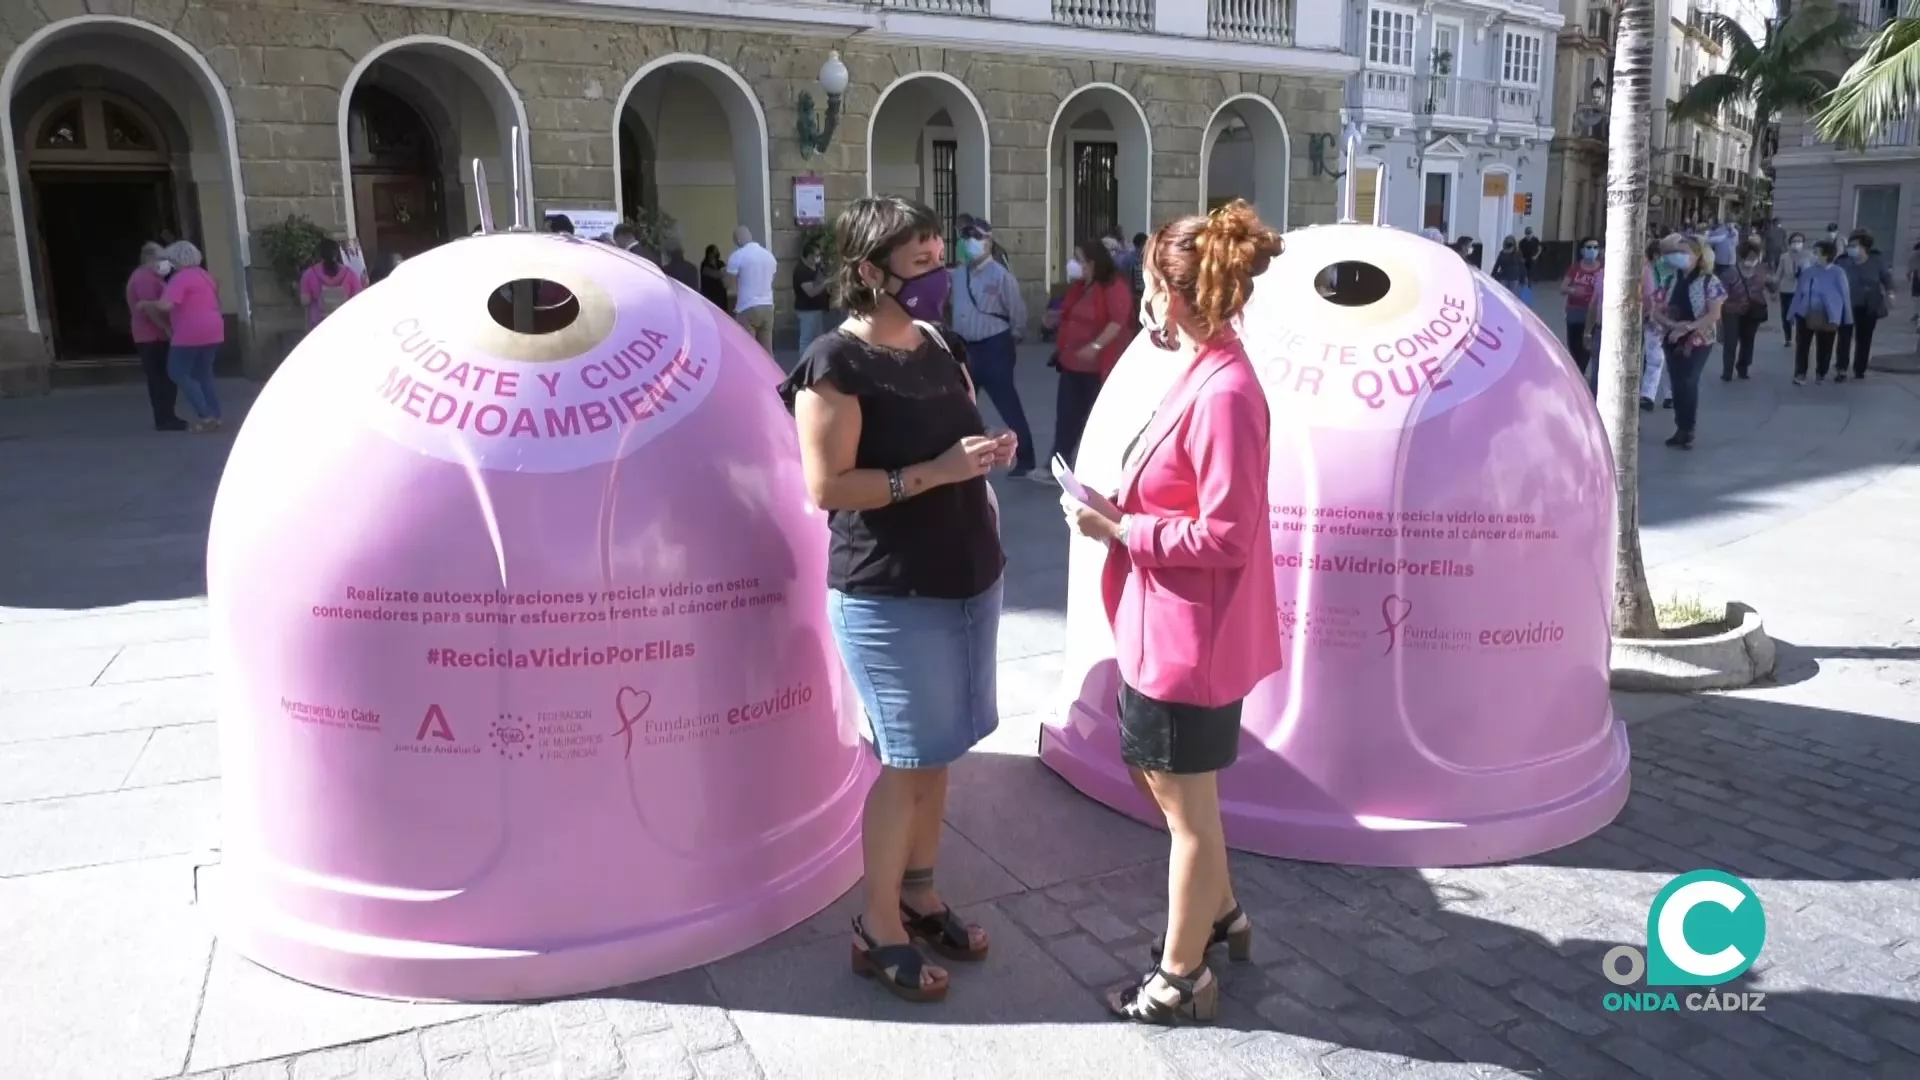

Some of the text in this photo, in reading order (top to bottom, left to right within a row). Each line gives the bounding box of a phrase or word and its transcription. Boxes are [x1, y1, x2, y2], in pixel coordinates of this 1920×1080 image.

[1320, 294, 1466, 365] TE CONOCE
[392, 317, 669, 398] CUÍDATE Y CUIDA
[1352, 355, 1454, 409] QUE
[1446, 510, 1485, 523] vidrio
[1329, 523, 1399, 538] esfuerzos
[1401, 525, 1444, 539] frente
[423, 588, 585, 607] autoexploraciones
[588, 591, 598, 606] y
[601, 585, 656, 603] recicla
[660, 582, 703, 598] vidrio
[312, 605, 419, 622] contenedores
[422, 610, 461, 625] para
[465, 611, 517, 625] sumar
[520, 608, 606, 624] esfuerzos
[609, 605, 658, 622] frente
[662, 602, 675, 617] al
[679, 599, 730, 616] cáncer
[1479, 620, 1565, 646] ecovidrio
[427, 640, 696, 668] #ReciclaVidrioPorEllas
[727, 681, 813, 726] ecovidrio
